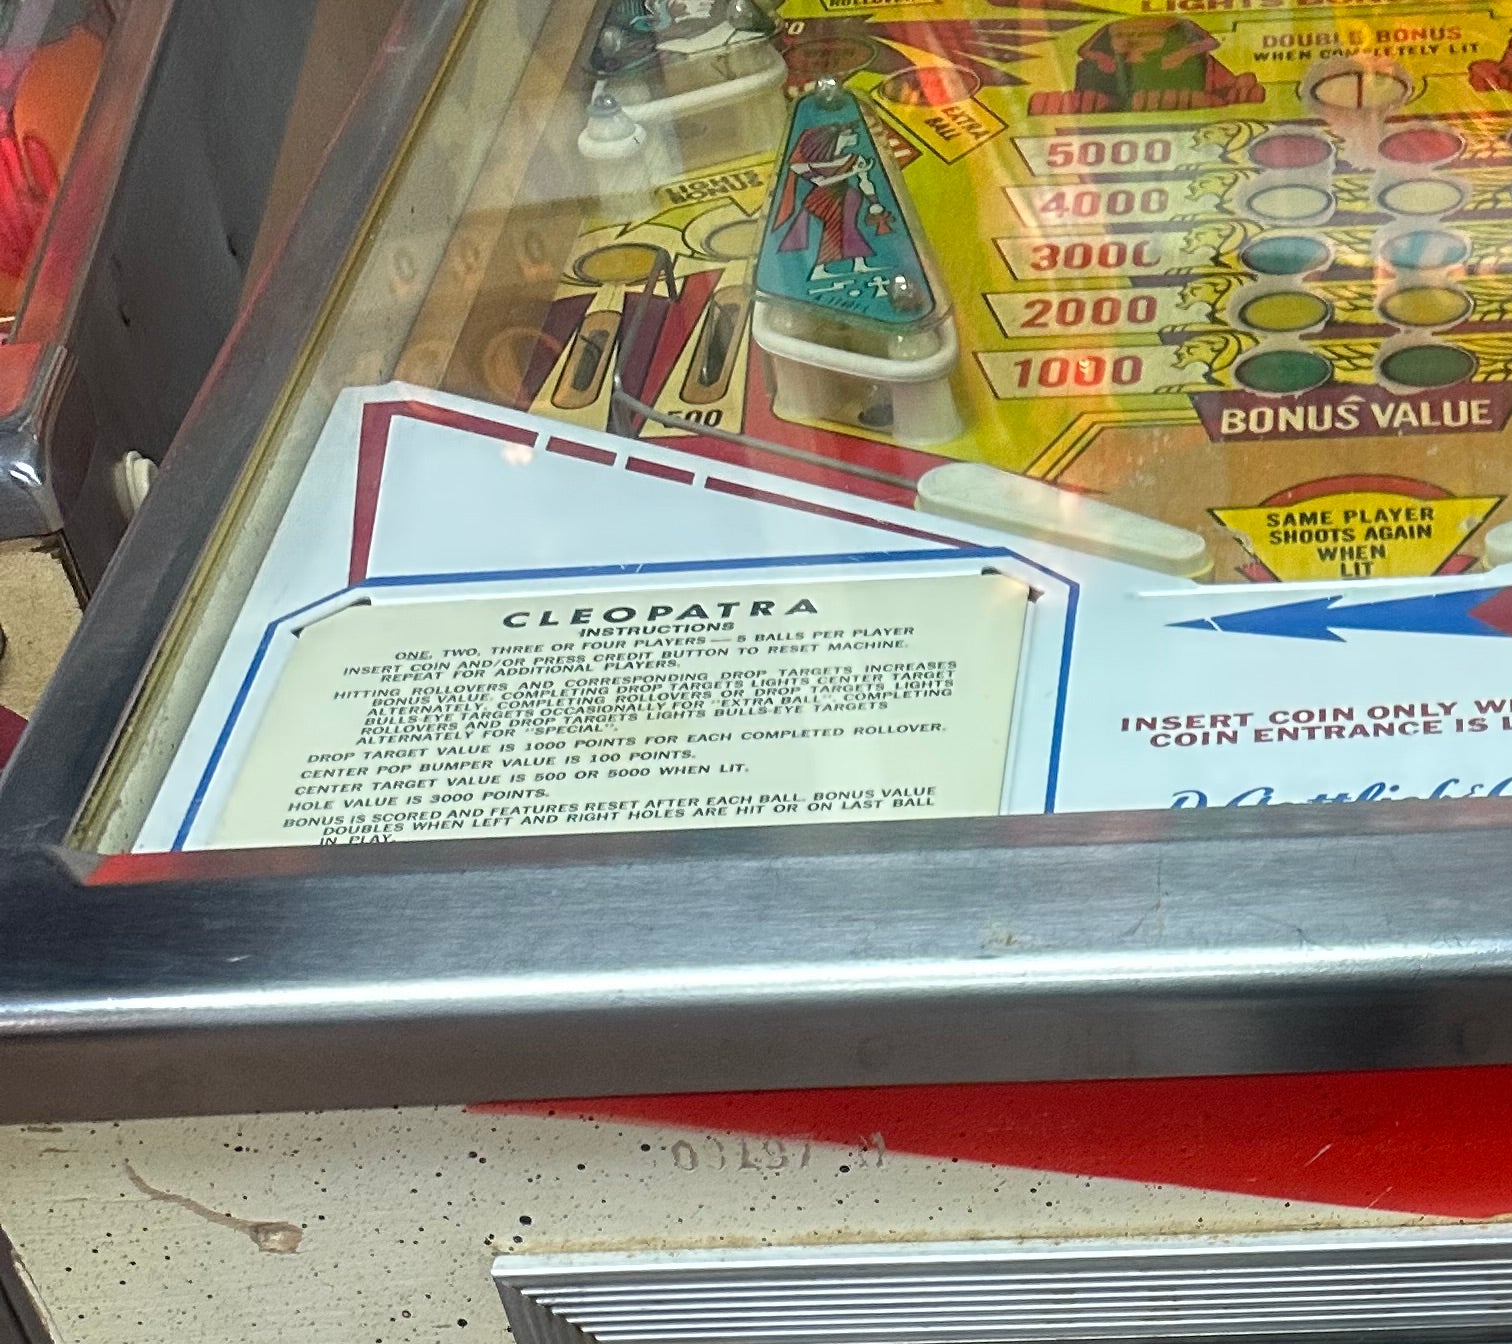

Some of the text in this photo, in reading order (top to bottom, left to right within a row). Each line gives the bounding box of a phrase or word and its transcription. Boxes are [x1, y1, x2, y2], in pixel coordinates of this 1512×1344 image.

[1376, 26, 1462, 44] BONUS
[1252, 49, 1312, 62] WHEN
[1449, 41, 1479, 54] LIT
[1046, 139, 1172, 168] 5000
[1039, 188, 1169, 219] 4000
[1030, 239, 1162, 272] 3000
[1020, 295, 1158, 329] 2000
[1013, 355, 1144, 388] 1000
[1220, 398, 1493, 435] BONUS VALUE
[1266, 506, 1435, 528] SAME PLAYER
[1268, 524, 1433, 545] SHOOTS AGAIN
[1316, 544, 1387, 562] WHEN
[1340, 561, 1375, 578] LIT
[502, 597, 818, 629] CLEOPATRA
[394, 625, 915, 660] ONE, TWO, THREE OR FOUR PLAYERS 5 BALLS PER PLAYER
[579, 621, 735, 638] INSTRUCTIONS
[342, 663, 403, 676] INSERT
[409, 660, 451, 672] COIN
[456, 657, 526, 670] AND/OR
[532, 654, 586, 666] PRESS
[592, 650, 652, 663] CREDIT
[660, 646, 730, 659] BUTTON
[737, 645, 759, 655] TO
[767, 642, 820, 654] RESET
[1121, 711, 1255, 732] INSERT
[1268, 705, 1355, 725] COIN
[1367, 700, 1458, 721] ONLY
[307, 722, 947, 763] DROP TARGET VALUE IS 1000 POINTS FOR EACH COMPLETED ROLLOVER.
[1148, 727, 1239, 749] COIN
[1253, 719, 1443, 744] ENTRANCE
[1454, 716, 1489, 735] IS
[293, 762, 750, 796] CENTER TARGET VALUE IS 500 OR 5000 WHEN LIT.
[300, 748, 696, 780] CENTER POP BUMPER VALUE IS 100 POINTS.
[282, 815, 344, 828] BONUS
[349, 814, 366, 824] IS
[371, 809, 442, 823] SCORED
[446, 807, 485, 818] AND
[489, 802, 579, 816] FEATURES
[584, 799, 640, 811] RESET
[643, 797, 700, 809] AFTER
[706, 794, 753, 806] EACH
[813, 789, 875, 801] BONUS
[880, 786, 937, 798] VALUE
[287, 788, 550, 812] HOLE VALUE IS 3000 POINTS.
[322, 796, 935, 835] DOUBLES WHEN LEFT AND RIGHT HOLES ARE HIT OR ON LAST BALL
[319, 837, 338, 846] IN
